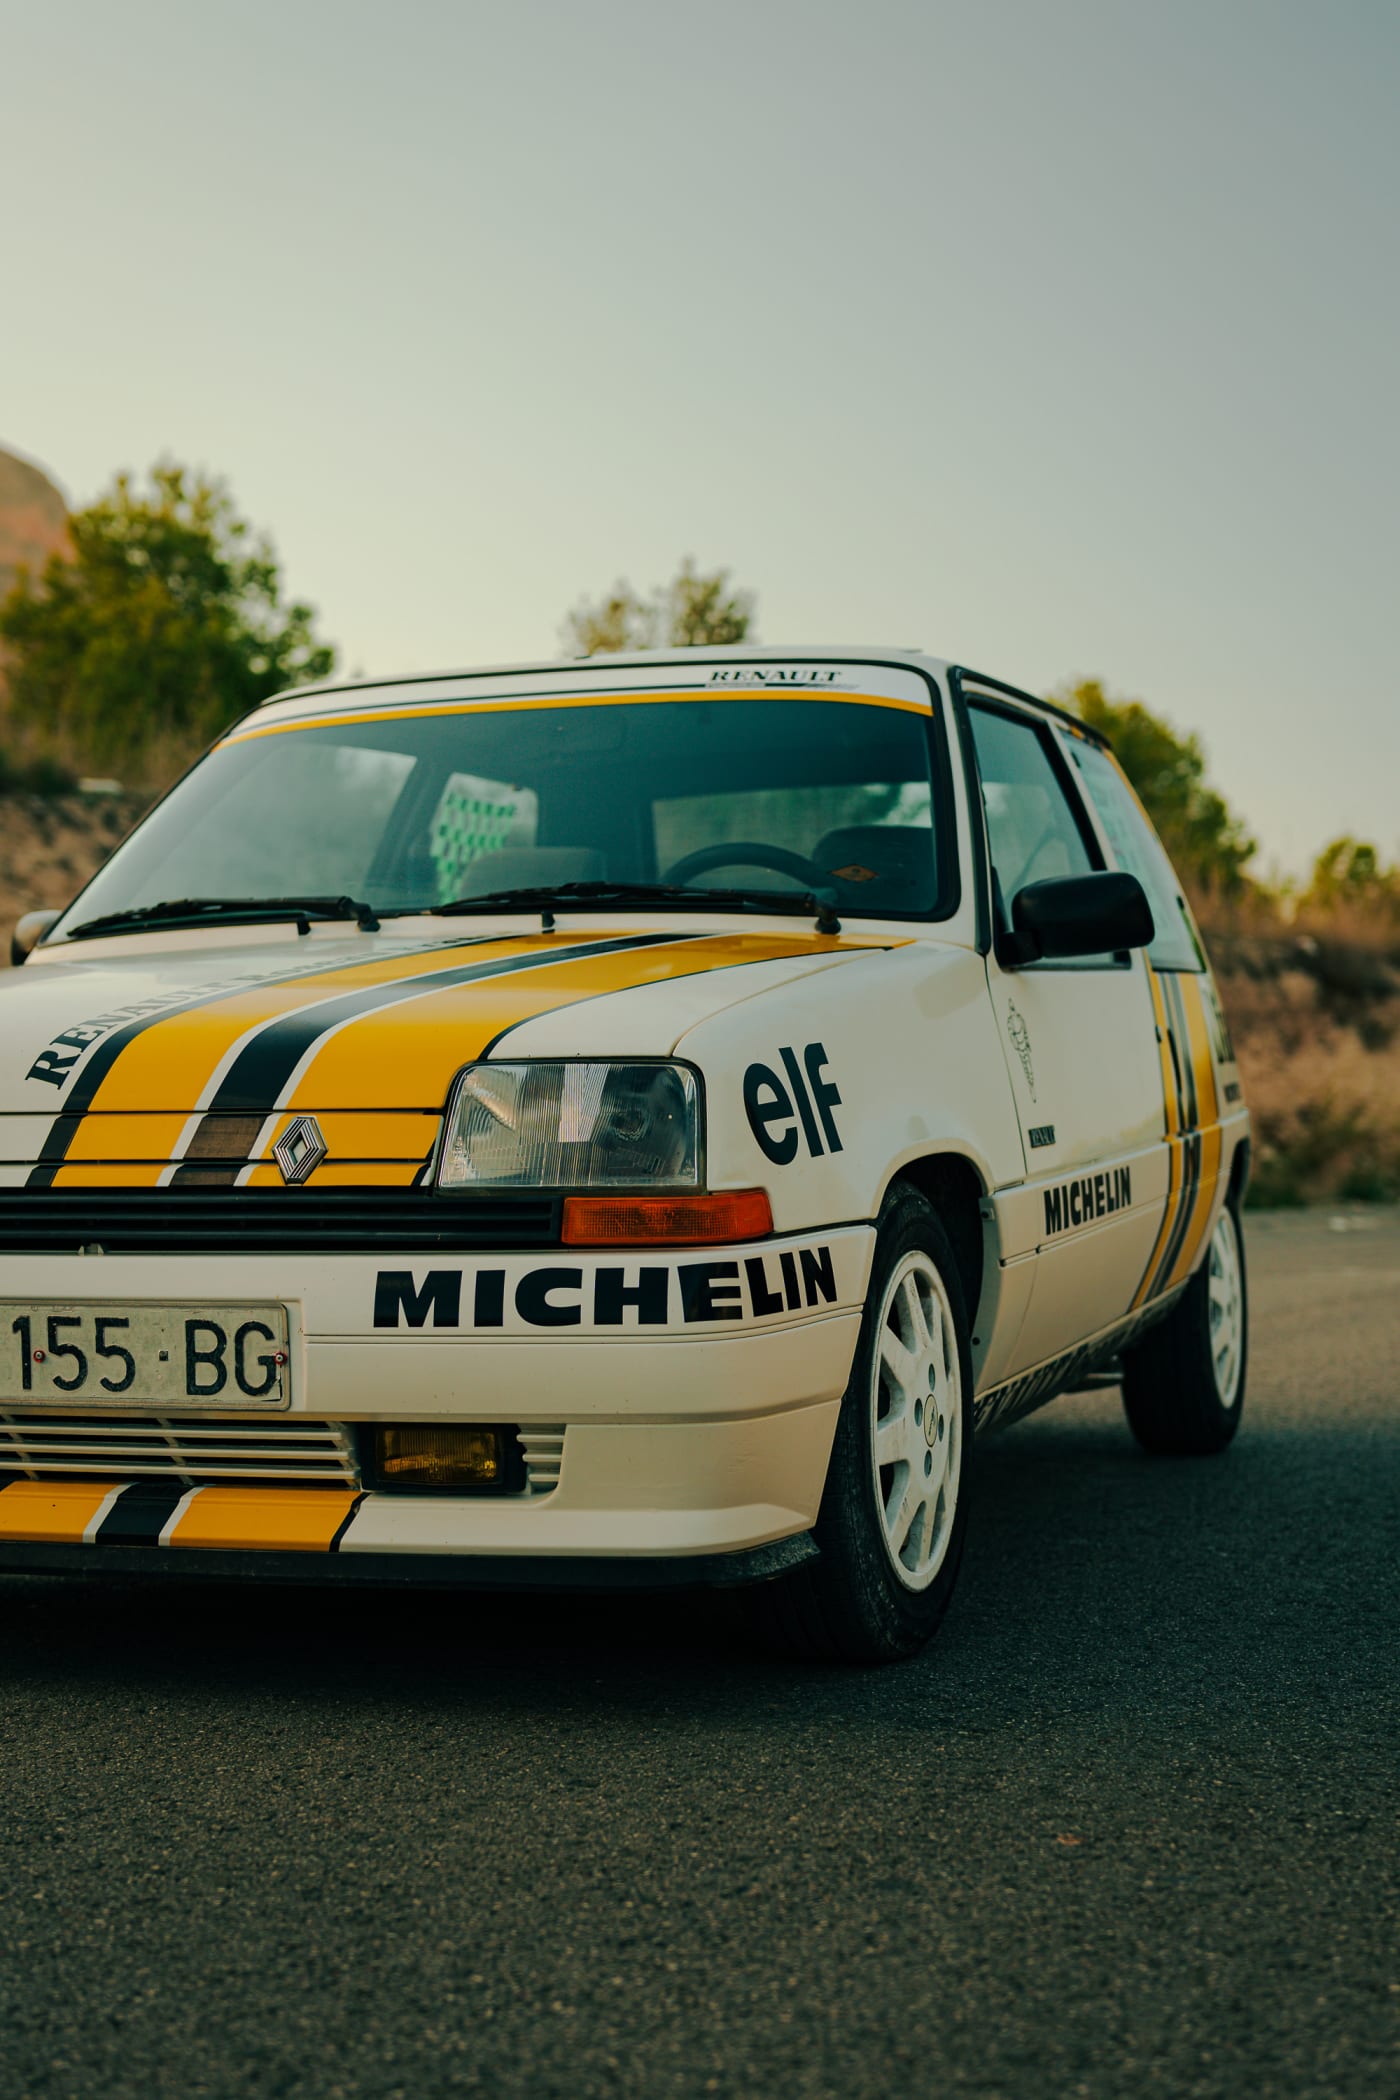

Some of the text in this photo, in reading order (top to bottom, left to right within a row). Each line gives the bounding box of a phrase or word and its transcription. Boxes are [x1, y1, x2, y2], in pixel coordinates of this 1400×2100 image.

[710, 671, 842, 681] RENAULT
[743, 1042, 843, 1165] elf
[1044, 1165, 1131, 1236] MICHELIN
[373, 1246, 838, 1328] MICHELIN
